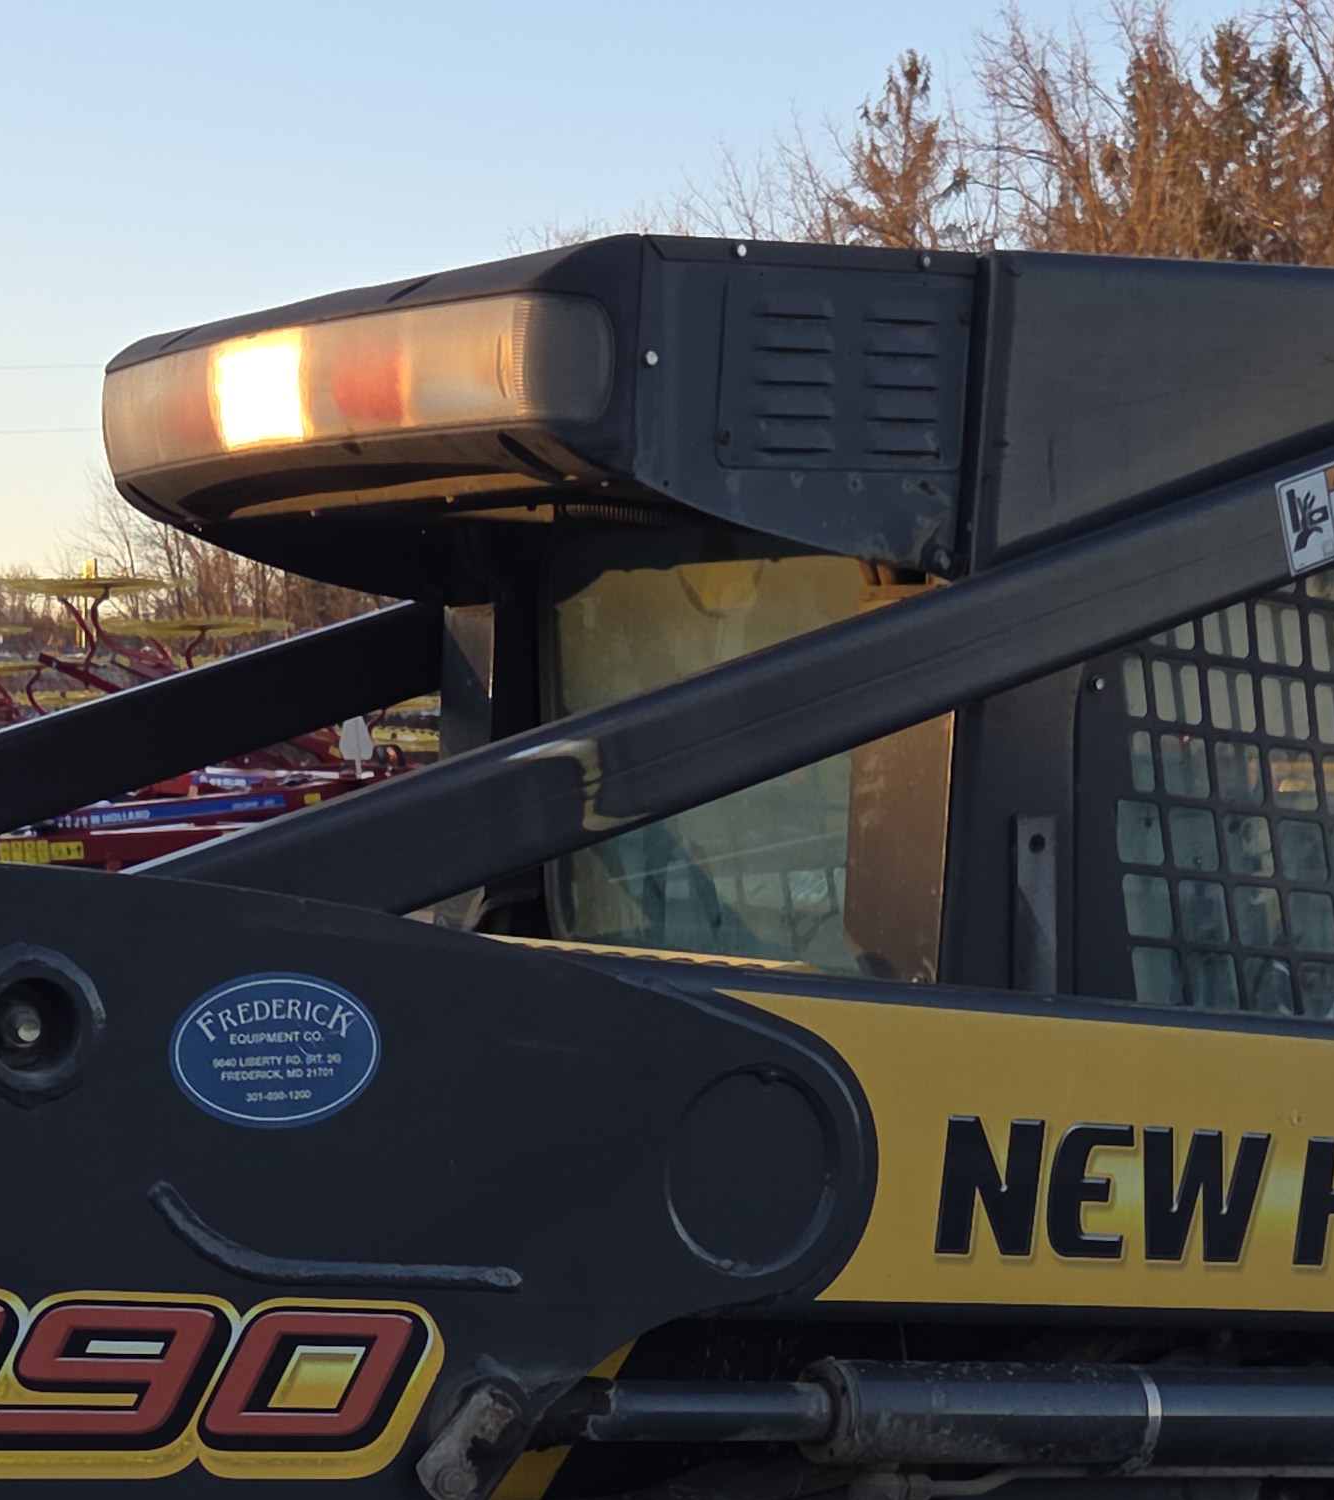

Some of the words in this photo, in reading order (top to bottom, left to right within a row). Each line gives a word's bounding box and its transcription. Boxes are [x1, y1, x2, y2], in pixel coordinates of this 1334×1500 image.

[196, 998, 355, 1042] FREDERICK
[229, 1031, 301, 1045] EQUIPMENT
[303, 1030, 325, 1042] CO.
[239, 1056, 282, 1067] LIBERTY
[286, 1069, 304, 1079] MD
[934, 1114, 1270, 1264] NEW
